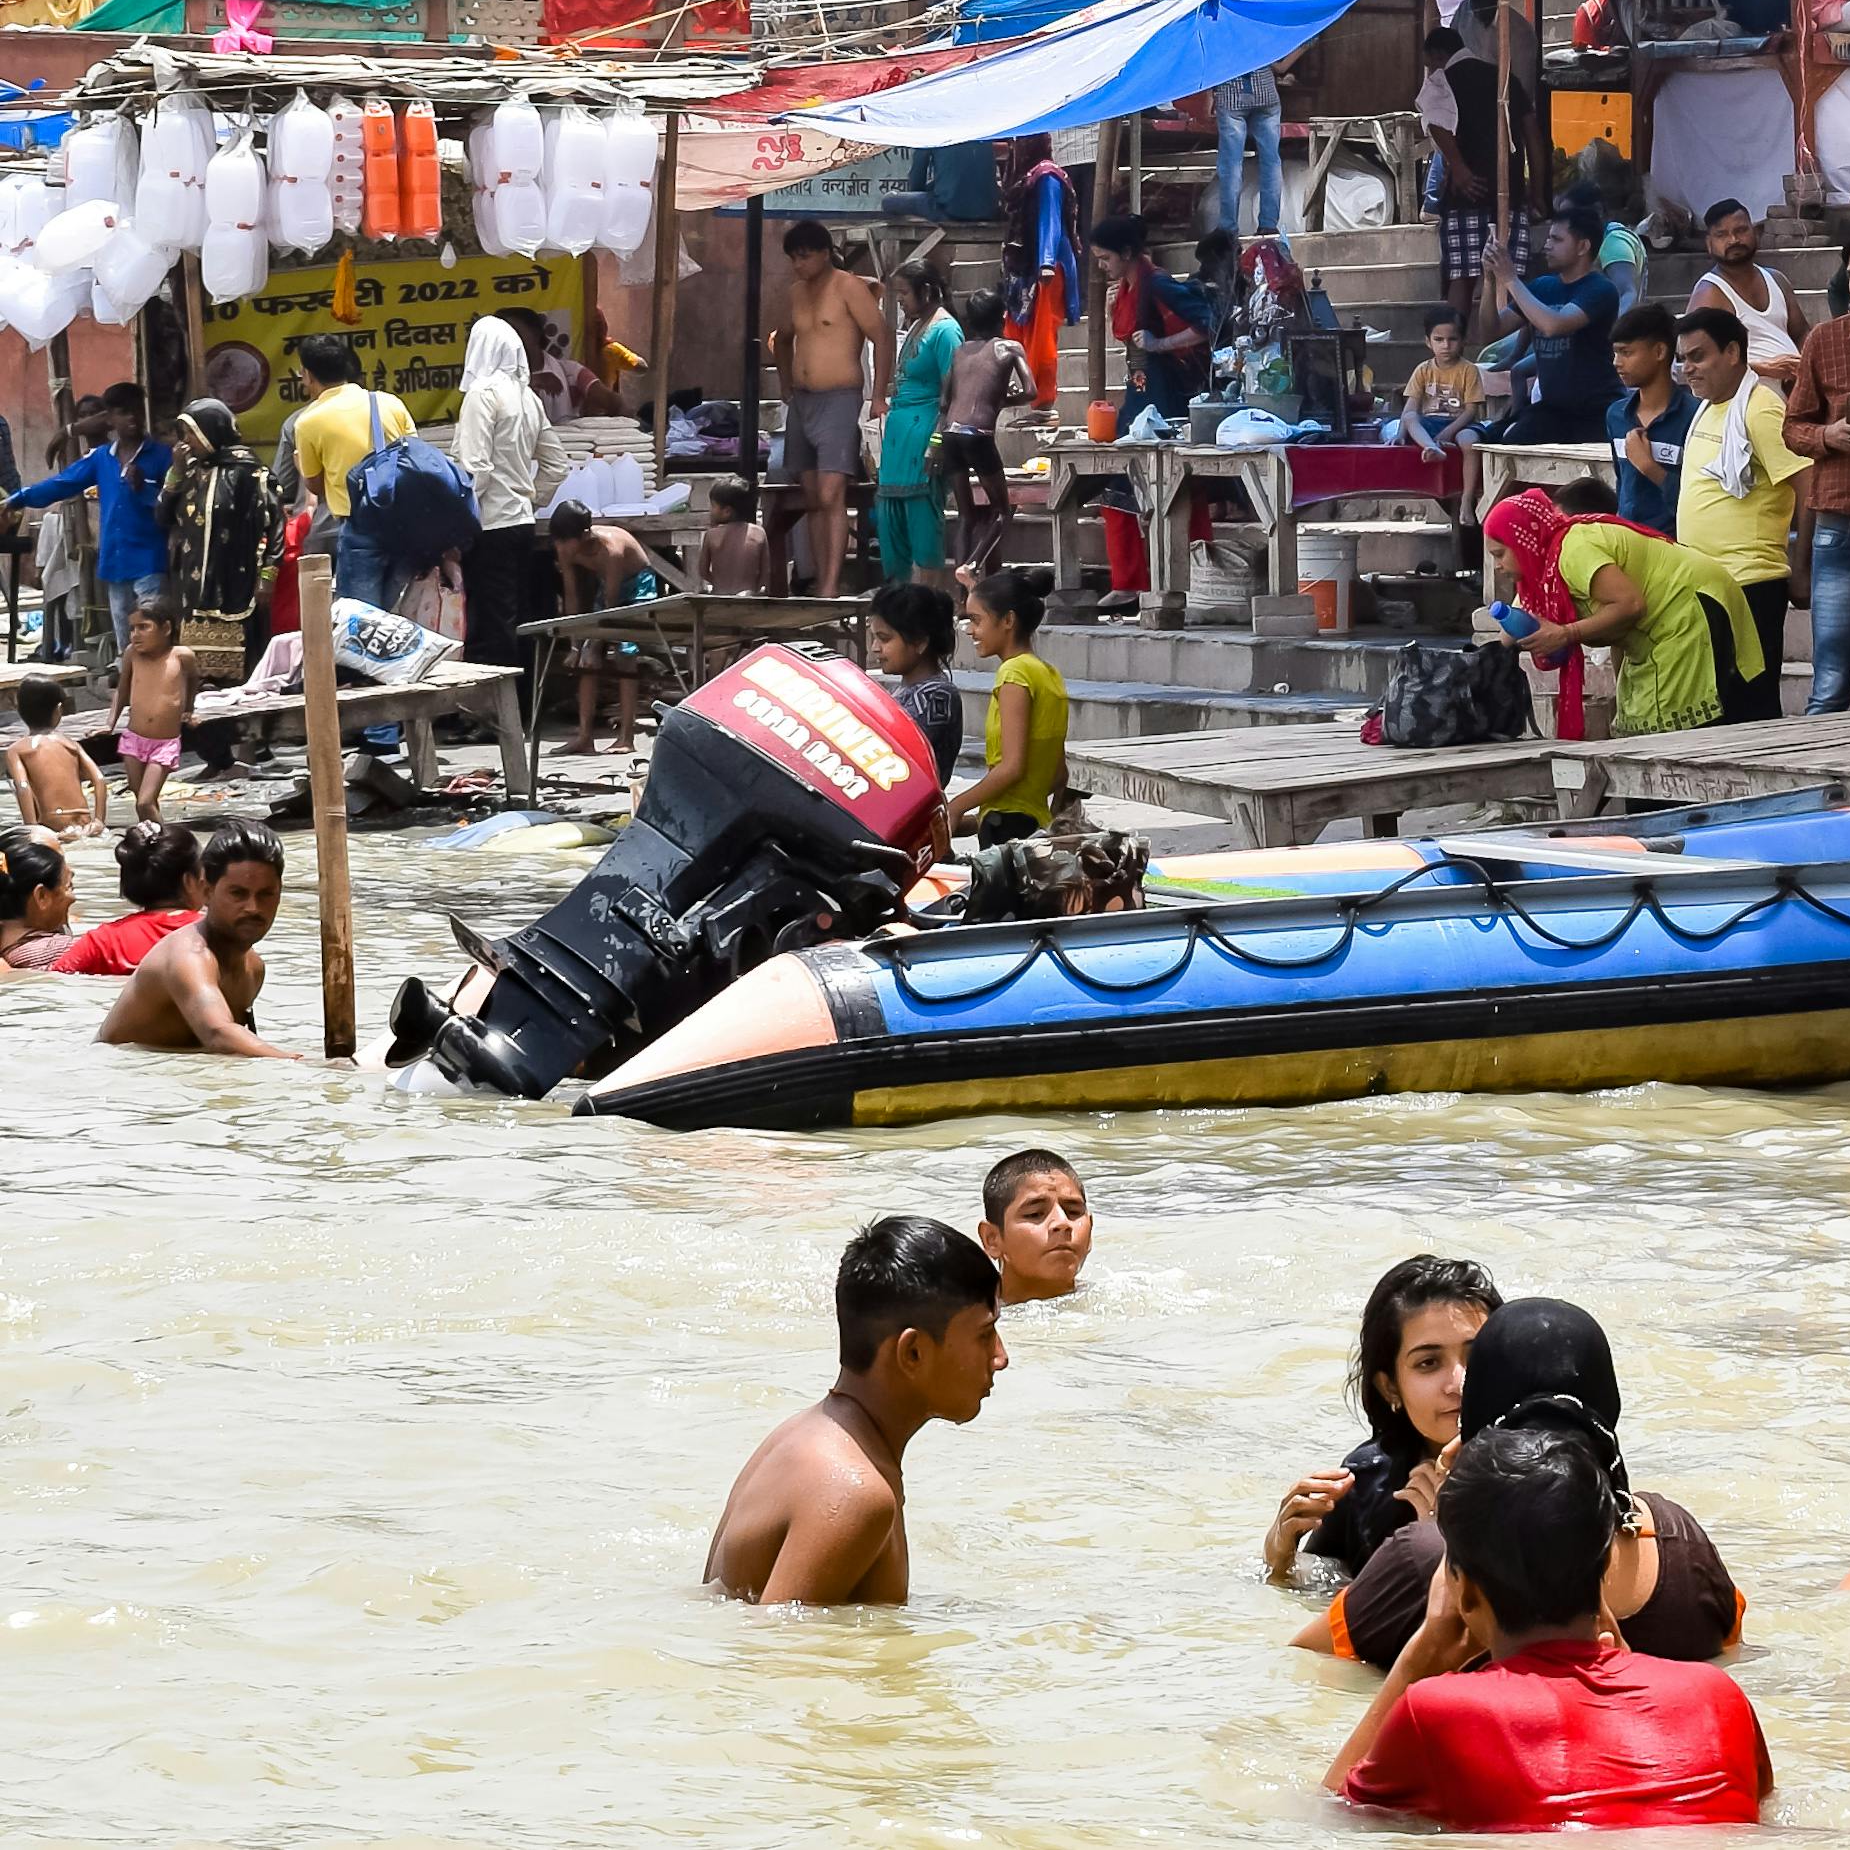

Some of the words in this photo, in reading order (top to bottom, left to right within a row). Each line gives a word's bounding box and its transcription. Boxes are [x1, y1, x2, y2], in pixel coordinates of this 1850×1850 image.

[821, 172, 873, 197] वन्यजीव
[398, 278, 480, 304] 2022
[491, 264, 553, 295] को
[384, 317, 457, 349] दिवस
[740, 655, 910, 792] MARINER
